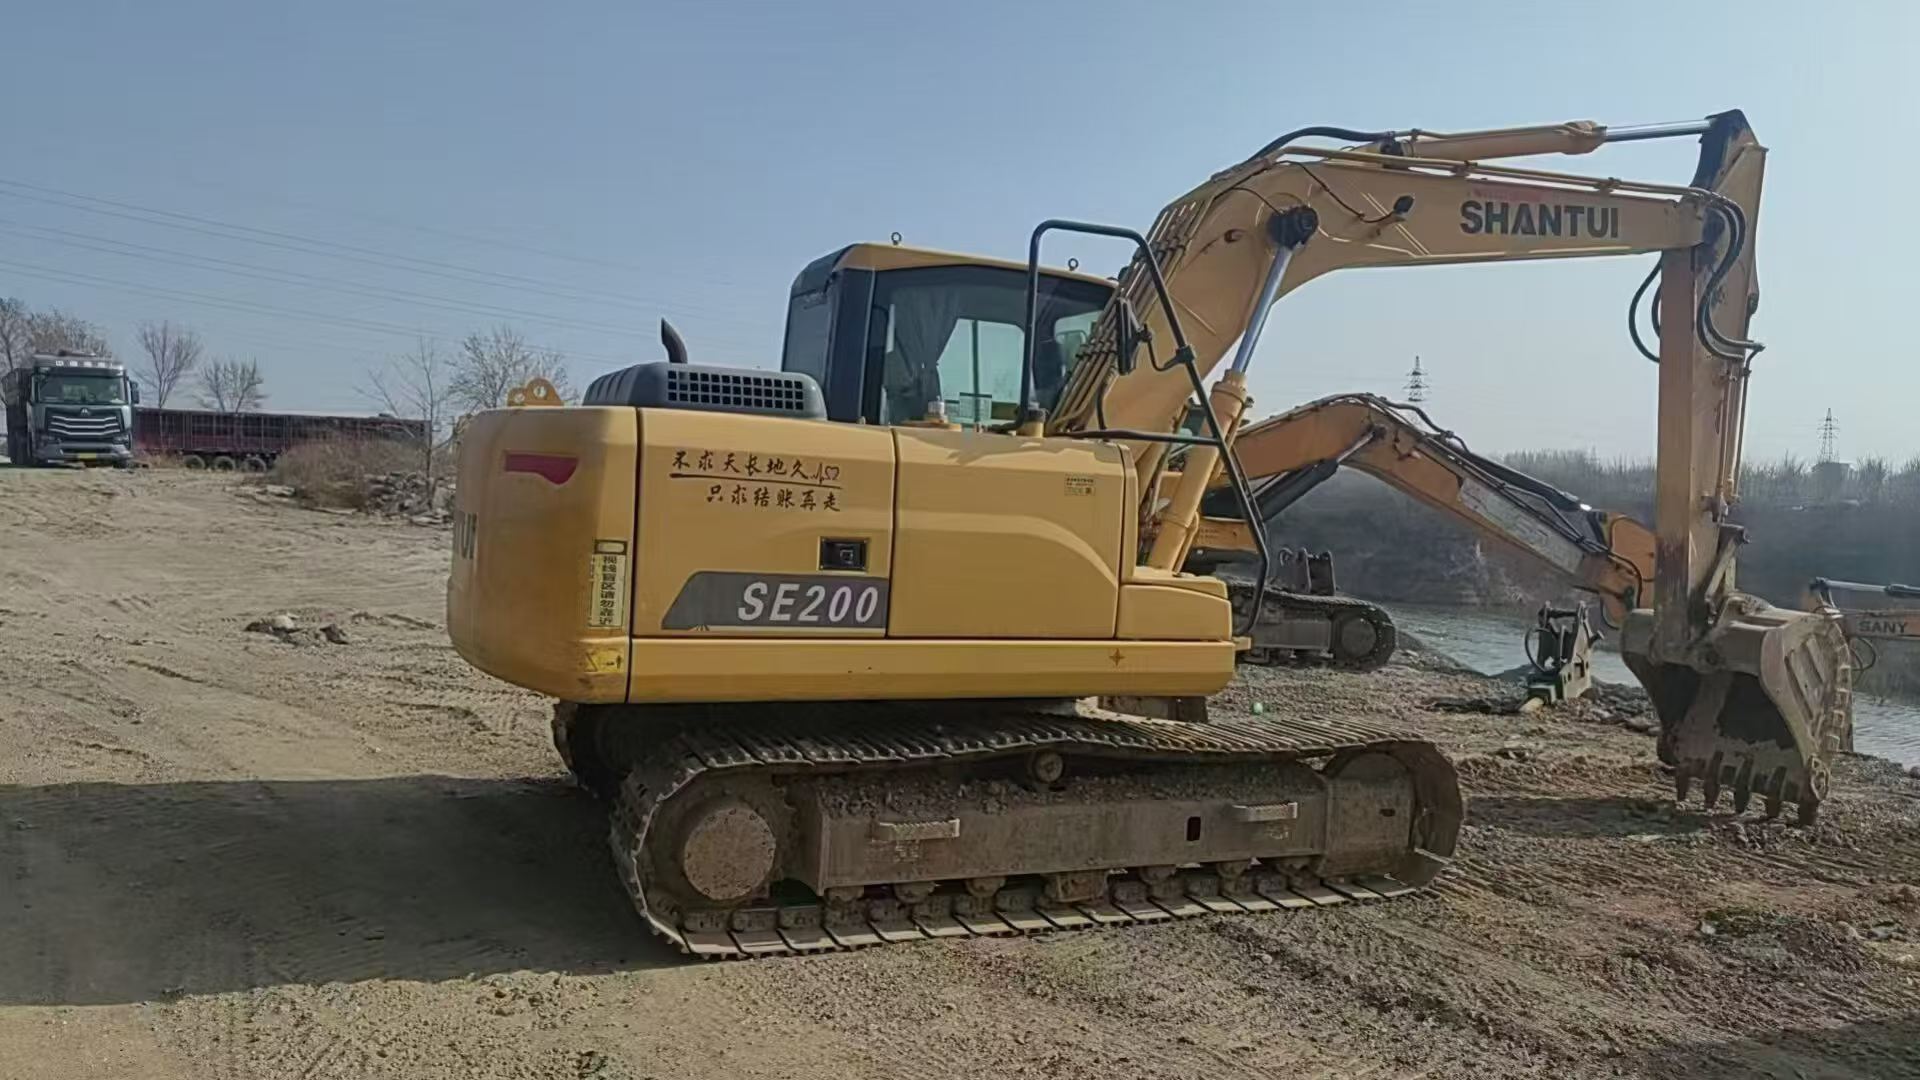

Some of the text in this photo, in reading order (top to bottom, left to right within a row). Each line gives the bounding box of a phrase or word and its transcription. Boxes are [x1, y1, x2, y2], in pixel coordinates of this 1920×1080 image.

[1460, 199, 1619, 239] SHANTUI
[672, 450, 809, 480] 不求天长地久
[706, 484, 841, 512] 只求结账再走
[737, 581, 879, 623] SE200
[1859, 620, 1907, 634] SANY
